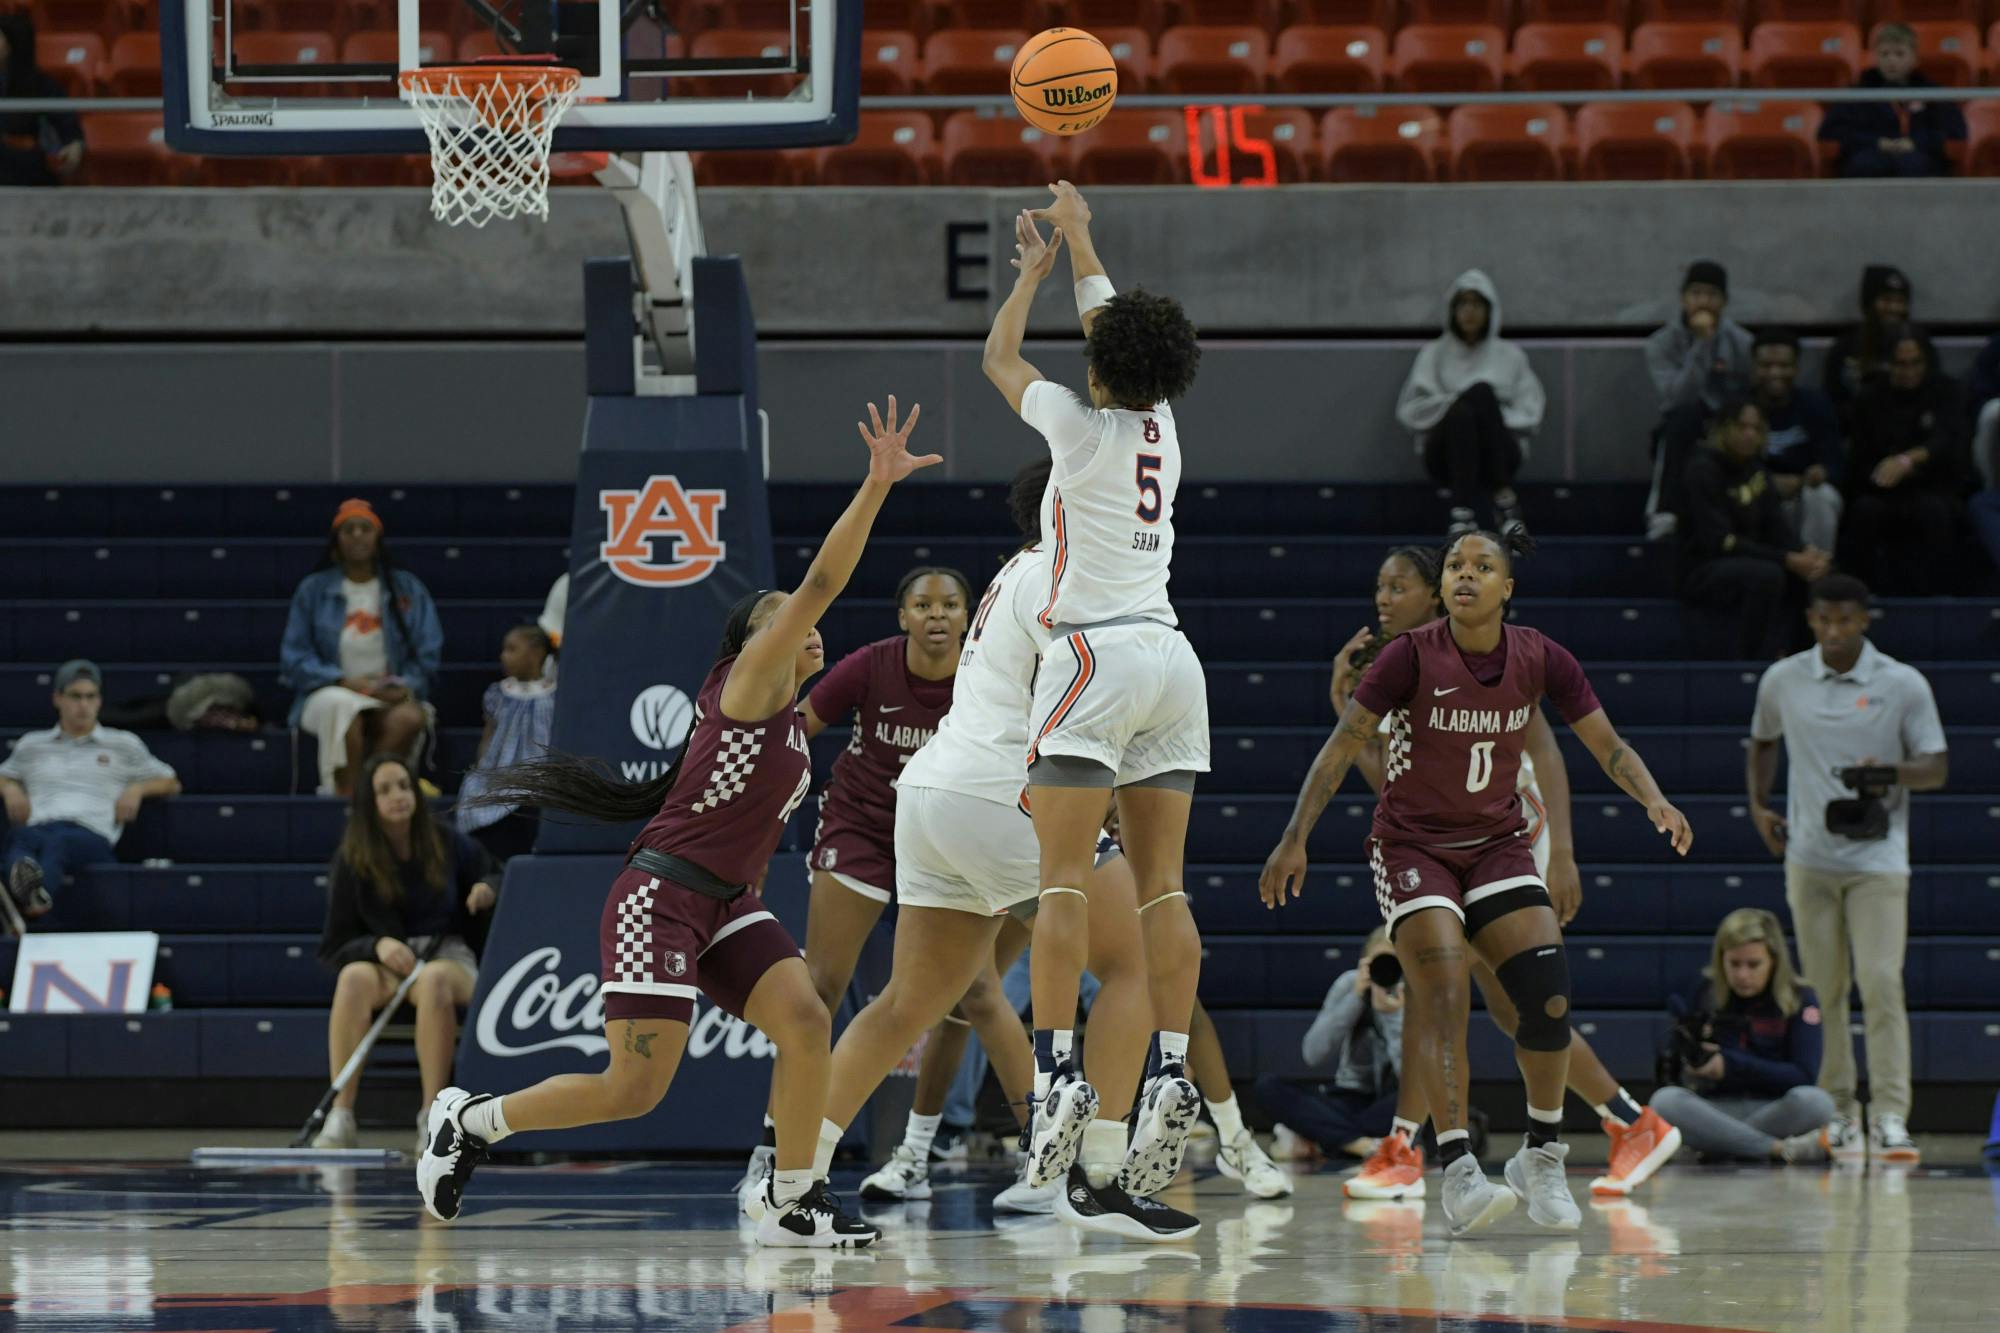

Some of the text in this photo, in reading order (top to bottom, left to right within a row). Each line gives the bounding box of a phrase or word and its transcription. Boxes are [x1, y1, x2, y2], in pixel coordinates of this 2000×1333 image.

[1042, 82, 1112, 107] Wilson
[211, 112, 273, 127] SPALDING
[946, 222, 990, 301] E
[1135, 453, 1163, 526] 5
[1132, 531, 1161, 552] SHAW
[1428, 704, 1530, 733] ALABAMA A&M
[875, 722, 940, 749] ALABAM
[1466, 741, 1496, 793] 0
